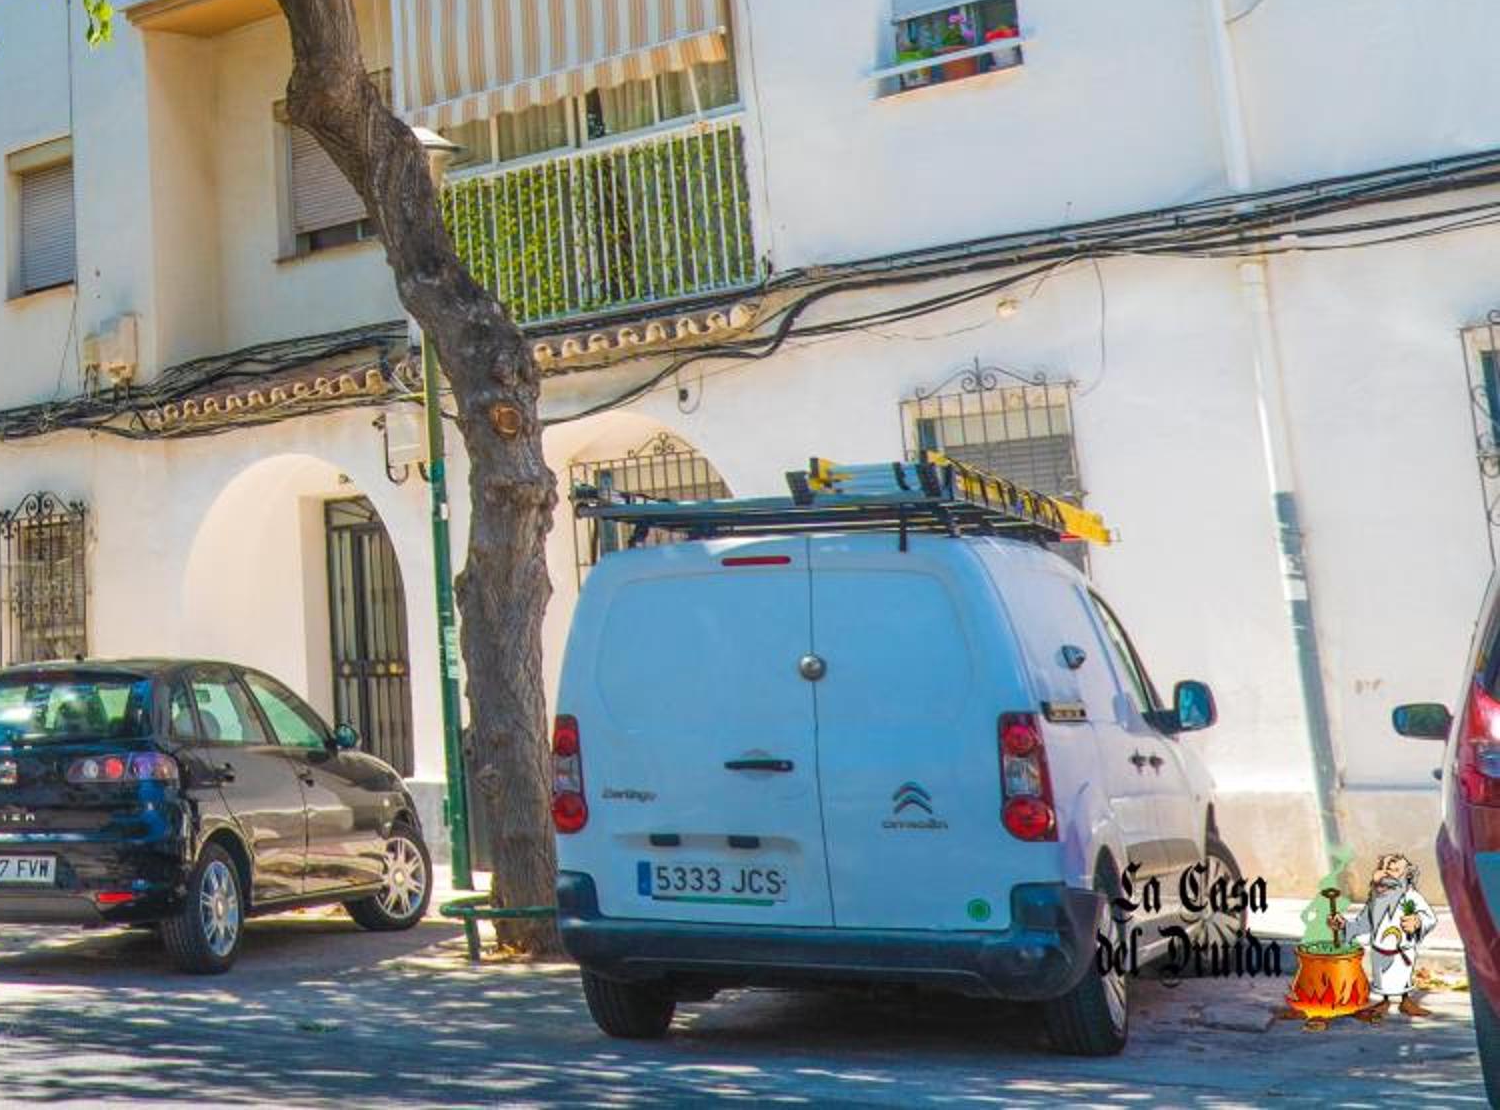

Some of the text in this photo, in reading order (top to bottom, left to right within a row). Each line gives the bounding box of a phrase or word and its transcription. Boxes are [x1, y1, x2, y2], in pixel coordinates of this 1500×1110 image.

[16, 859, 51, 878] FVW
[656, 865, 782, 895] 5333 JCS
